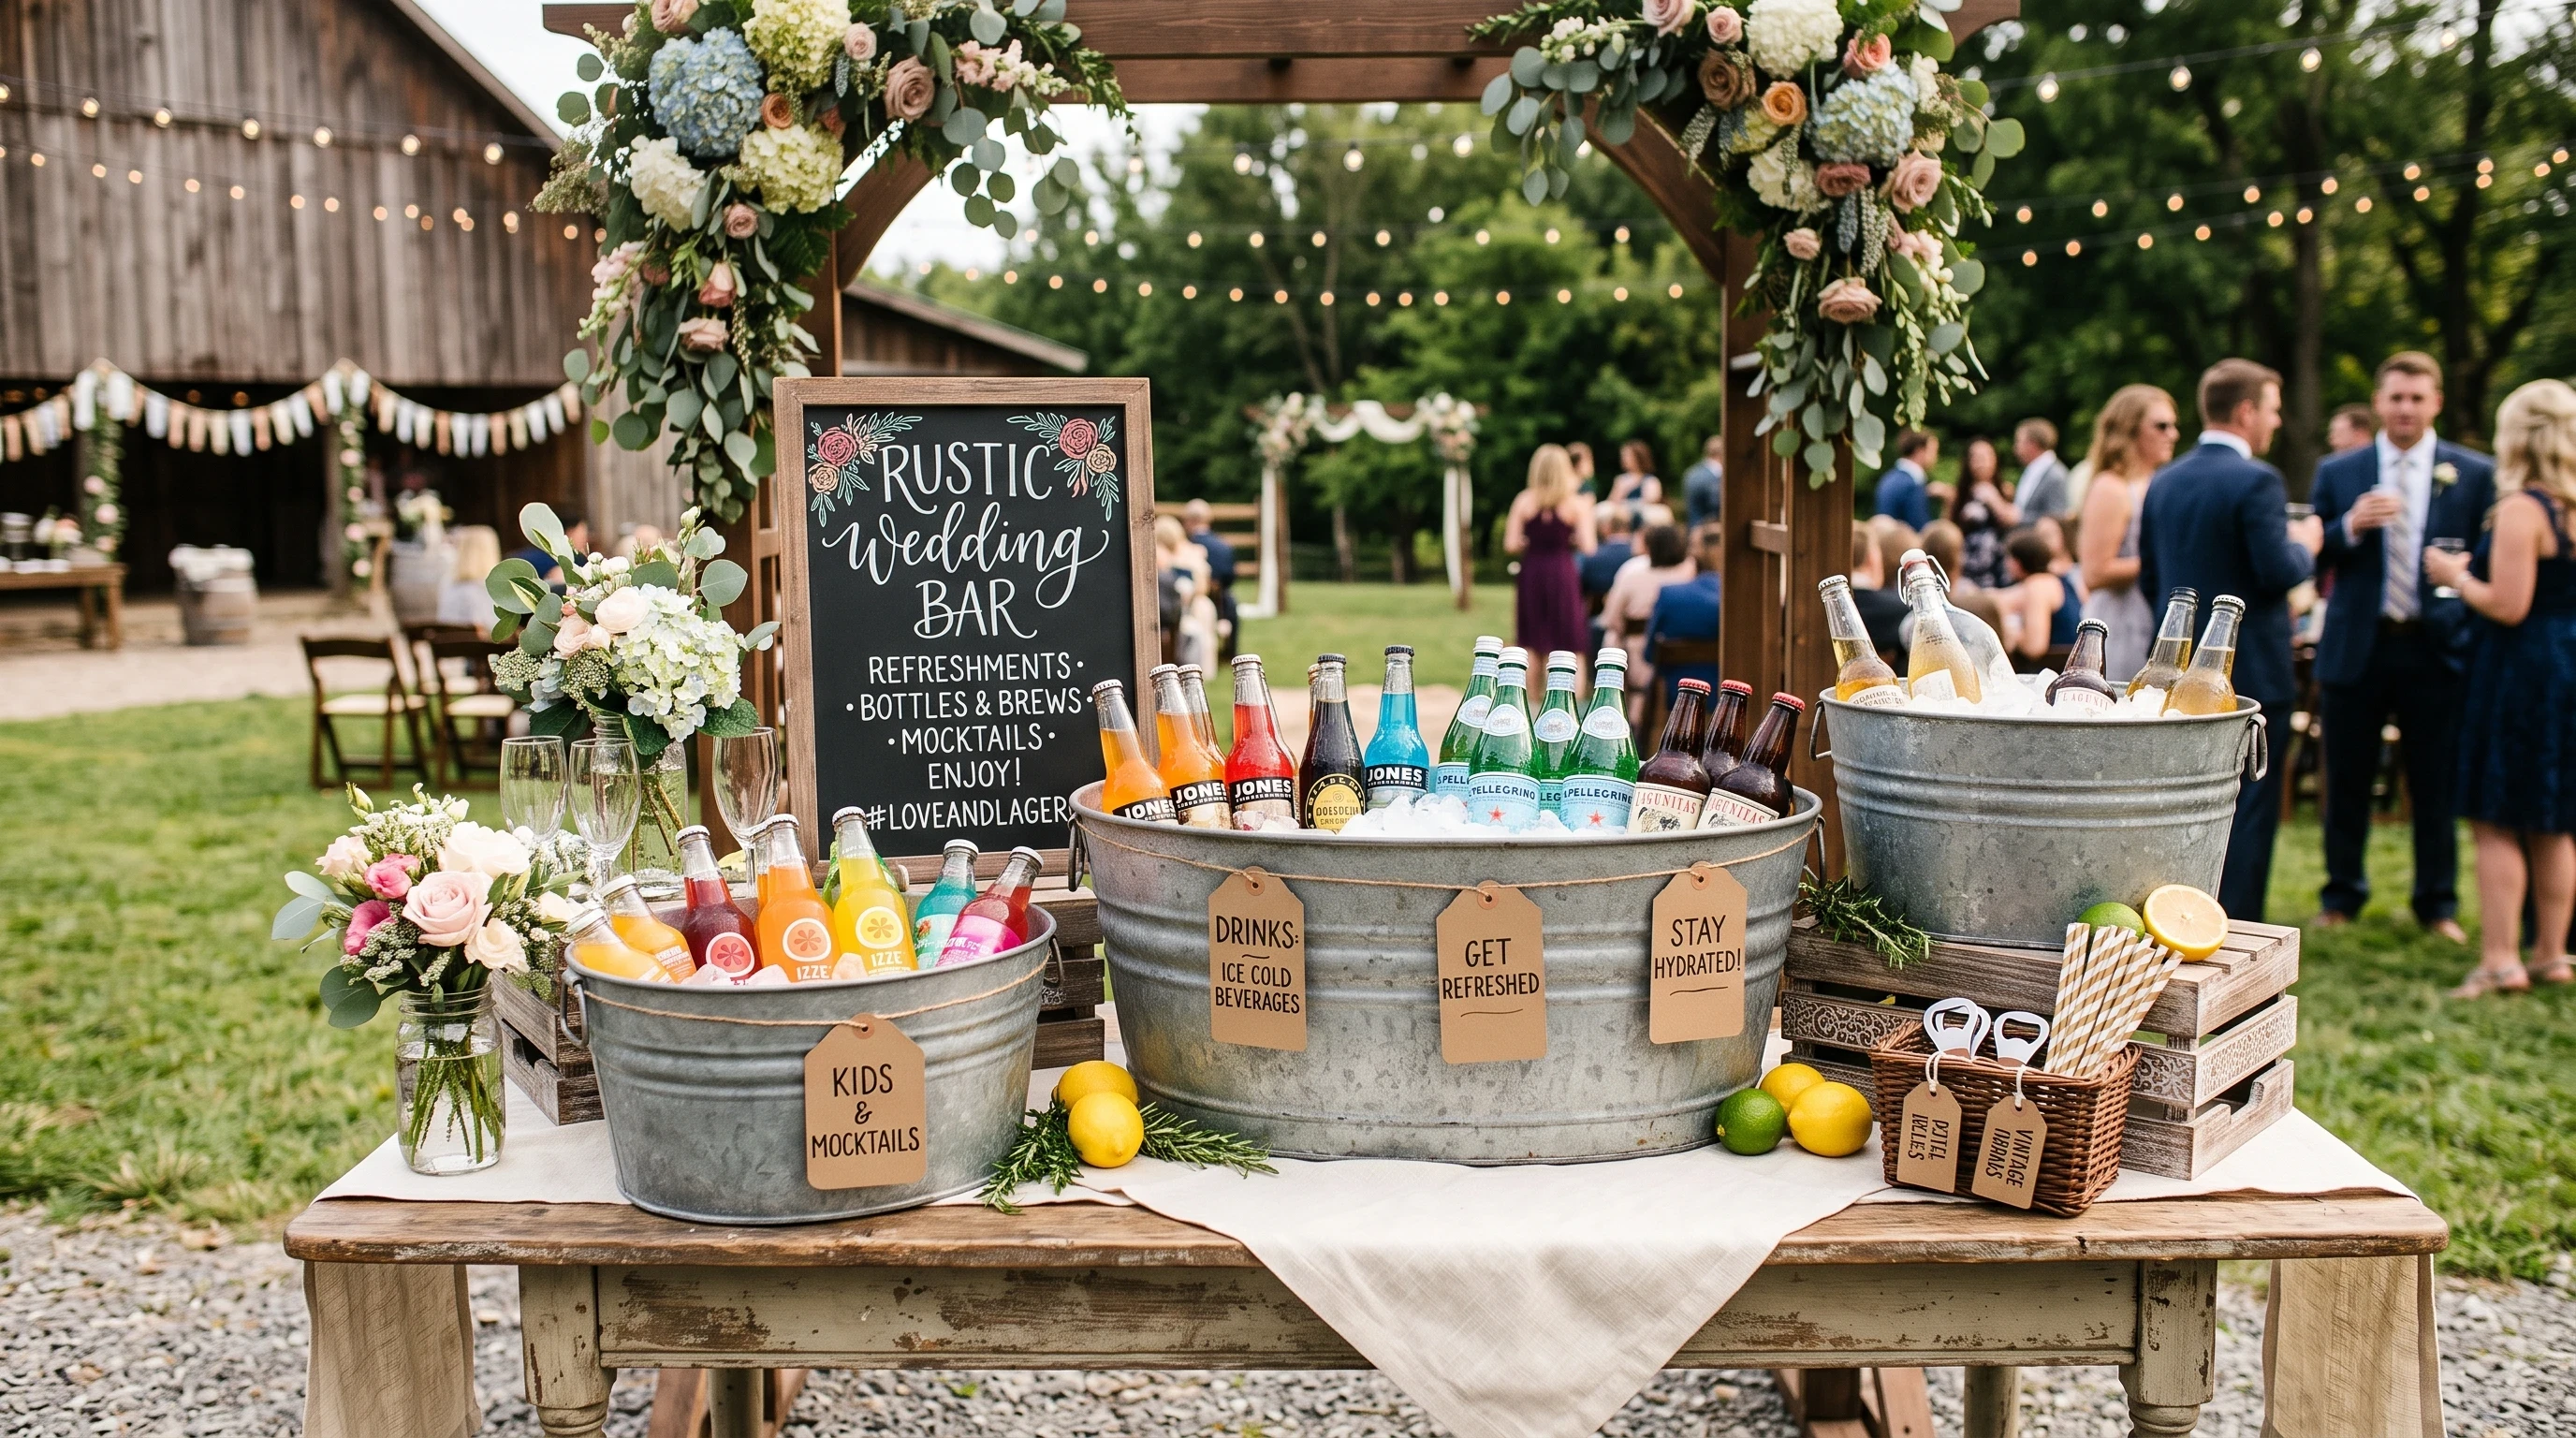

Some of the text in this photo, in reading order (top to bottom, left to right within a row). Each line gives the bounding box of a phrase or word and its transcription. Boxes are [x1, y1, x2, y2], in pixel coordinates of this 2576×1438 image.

[879, 442, 1053, 514] RUSTIC
[822, 501, 1109, 609] Wedding
[914, 579, 1037, 638] BAR
[869, 653, 1071, 684] REFRESHMENTS
[860, 686, 1082, 721] BOTTLES & BREWS
[902, 723, 1043, 754] MOCKTAILS
[929, 758, 1021, 789] ENJOY!
[1235, 780, 1292, 798] JONES
[1368, 767, 1423, 783] JONES
[1216, 915, 1299, 949] DRINKS:
[1671, 915, 1726, 947] STAY
[871, 951, 903, 966] IZZE
[1465, 938, 1512, 968] GET
[1654, 950, 1742, 979] HYDRATED!
[796, 965, 829, 980] IZZE
[1222, 961, 1292, 988] ICE COLD
[1442, 972, 1540, 1000] REFRESHED
[1215, 986, 1300, 1014] BEVERAGES
[832, 1064, 893, 1097] KIDS
[855, 1101, 872, 1124] &
[812, 1126, 920, 1159] MOCKTAILS
[2006, 1129, 2034, 1189] VINTAGE
